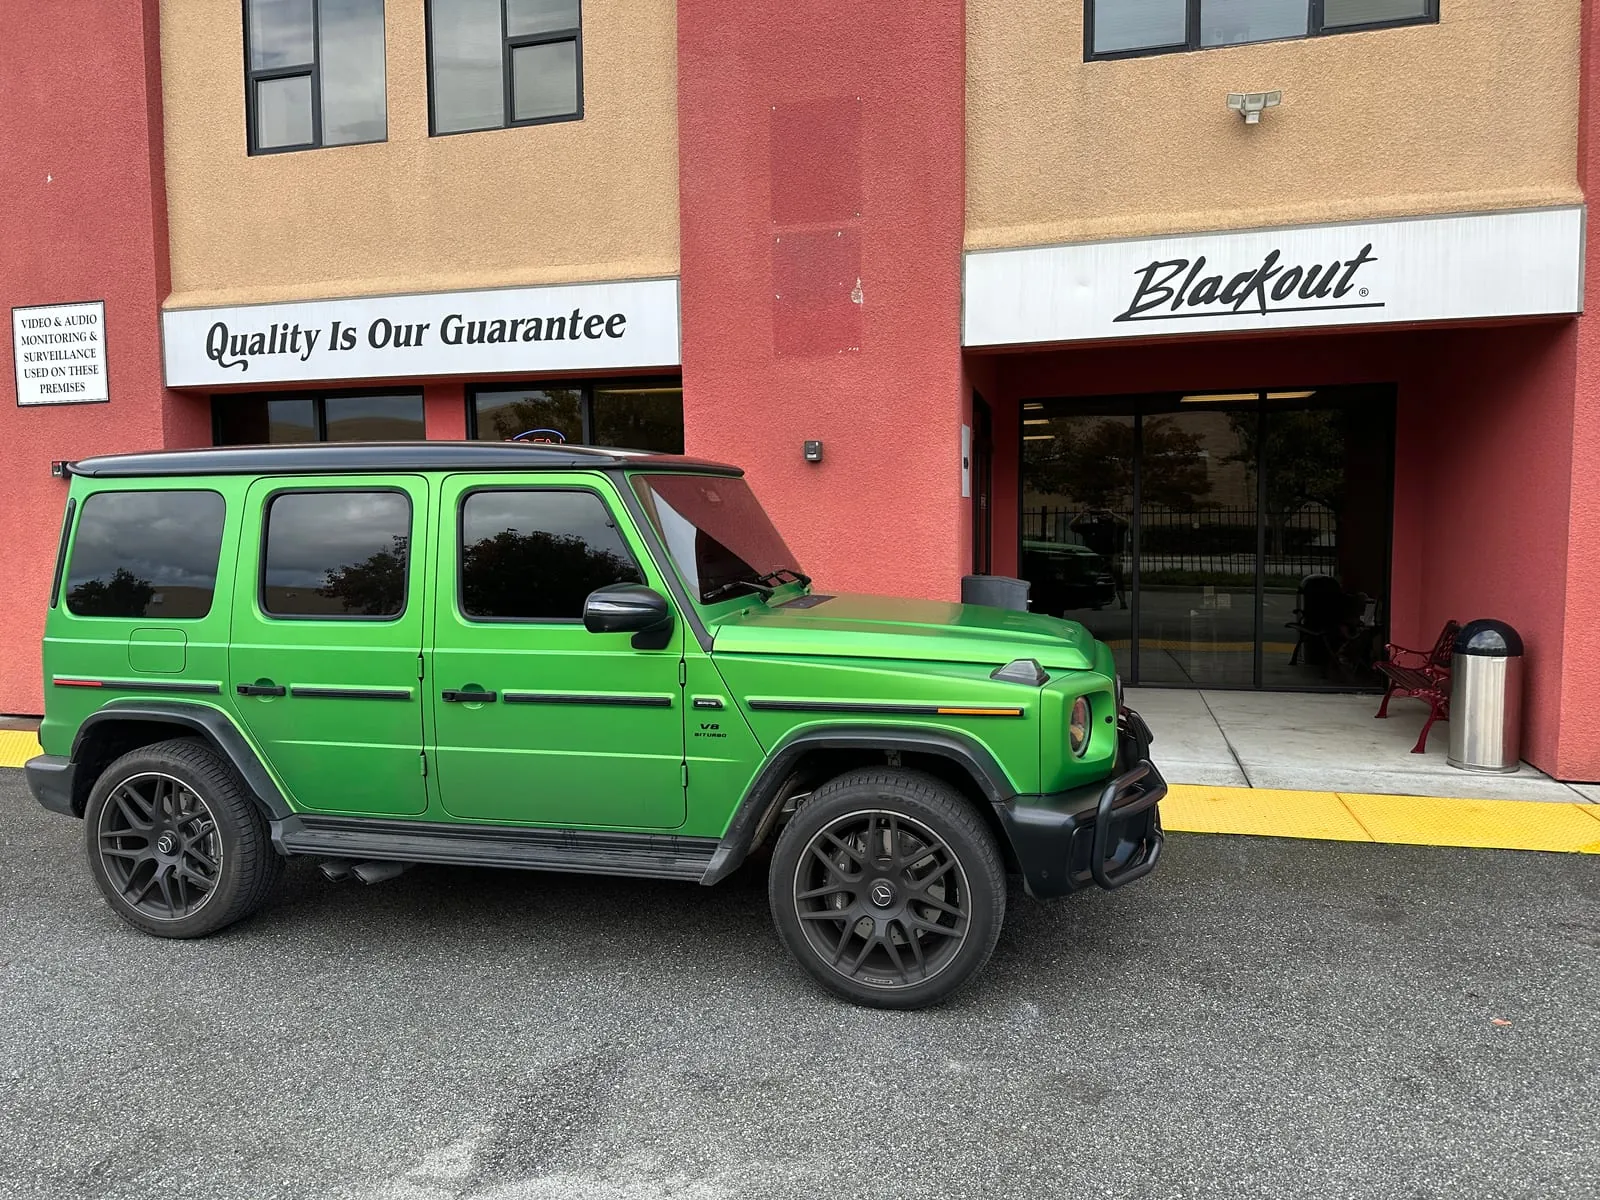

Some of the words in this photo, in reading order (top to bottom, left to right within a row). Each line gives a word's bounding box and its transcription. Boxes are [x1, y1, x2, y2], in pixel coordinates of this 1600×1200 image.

[1113, 243, 1385, 322] Blackout
[21, 317, 52, 329] VIDEO
[54, 316, 62, 327] &
[65, 314, 98, 326] AUDIO
[21, 332, 87, 346] MONITORING
[89, 331, 98, 341] &
[206, 321, 322, 371] Quality
[328, 318, 357, 351] Is
[367, 317, 431, 348] Our
[440, 308, 627, 346] Guarantee
[24, 348, 97, 362] SURVEILLANCE
[24, 367, 49, 379] USED
[50, 366, 66, 377] ON
[68, 364, 99, 376] THESE
[40, 382, 86, 394] PREMISES
